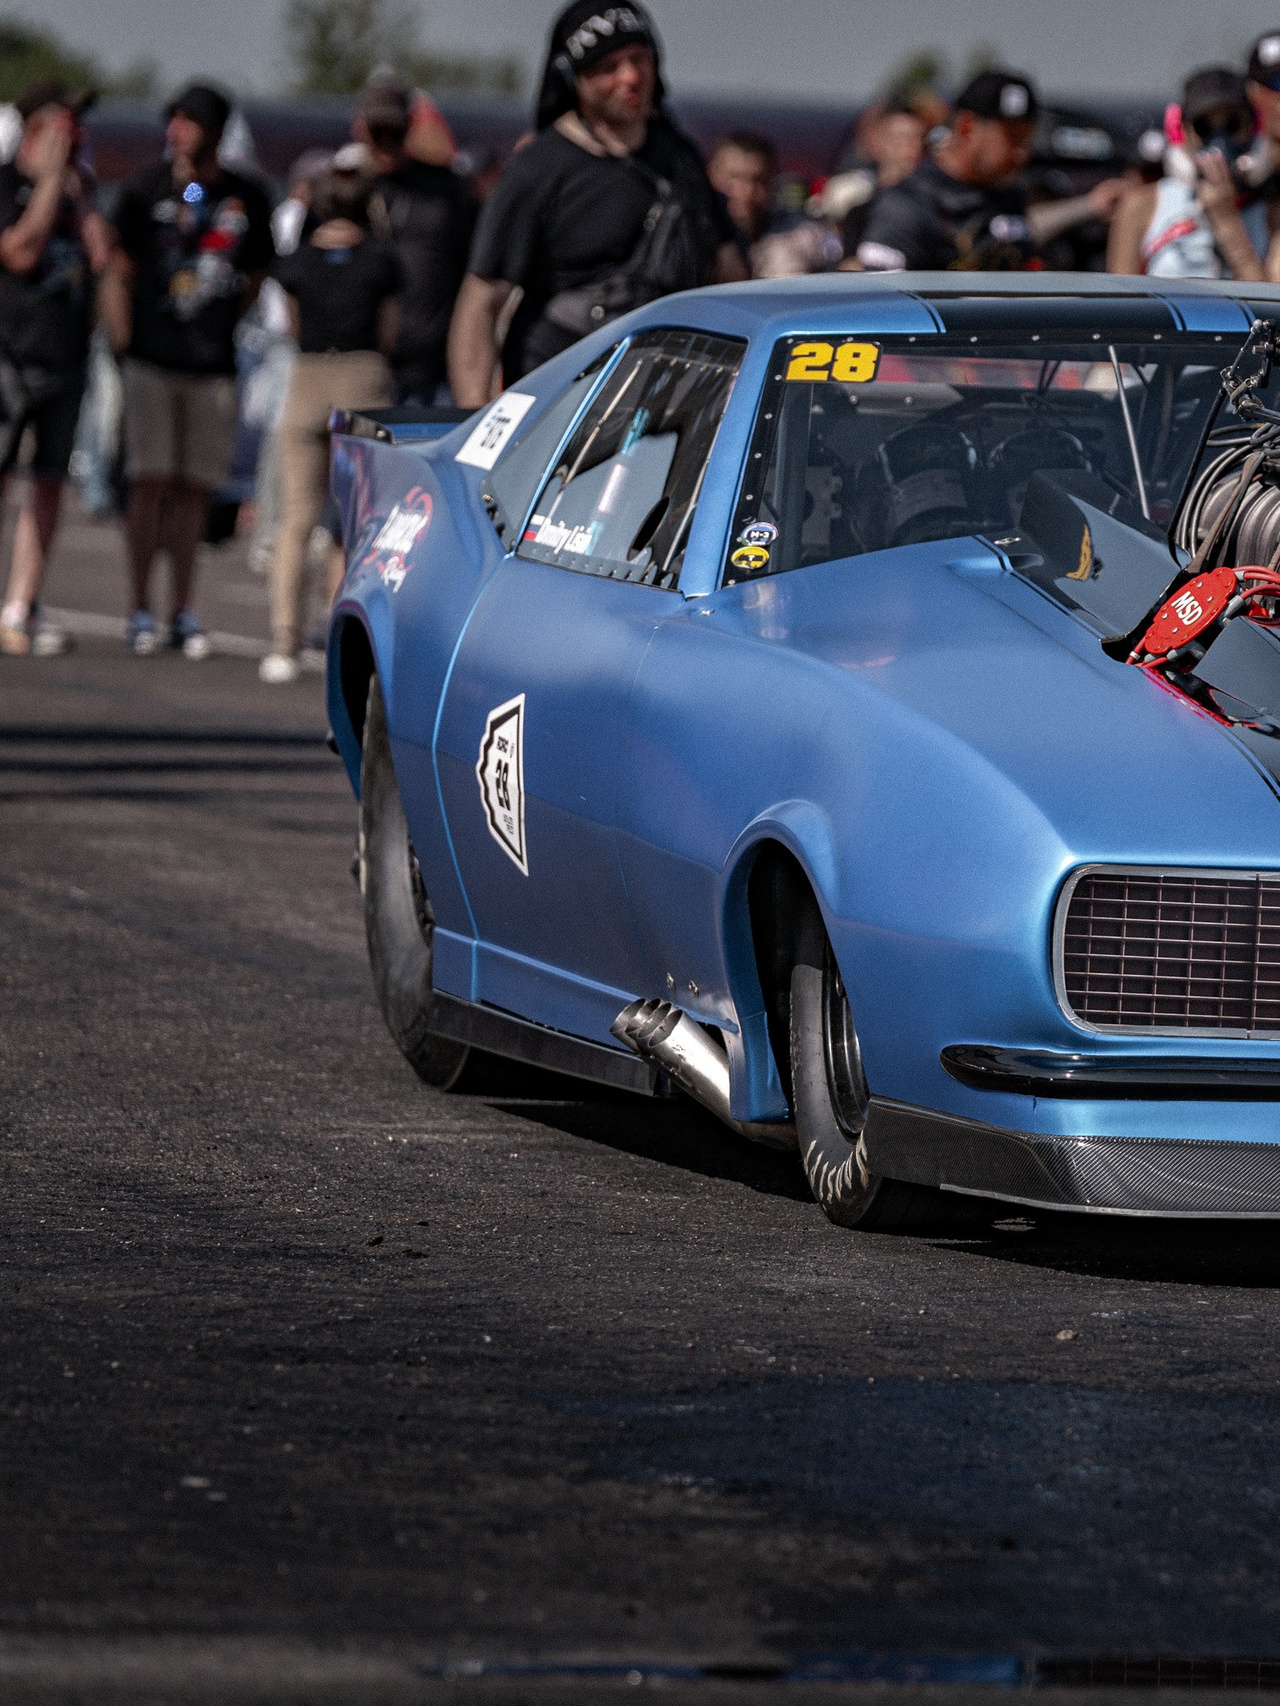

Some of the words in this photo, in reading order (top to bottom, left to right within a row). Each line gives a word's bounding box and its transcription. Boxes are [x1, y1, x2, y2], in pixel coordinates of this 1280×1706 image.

[786, 343, 879, 382] 28
[1171, 591, 1202, 625] MSD
[496, 758, 511, 812] 28
